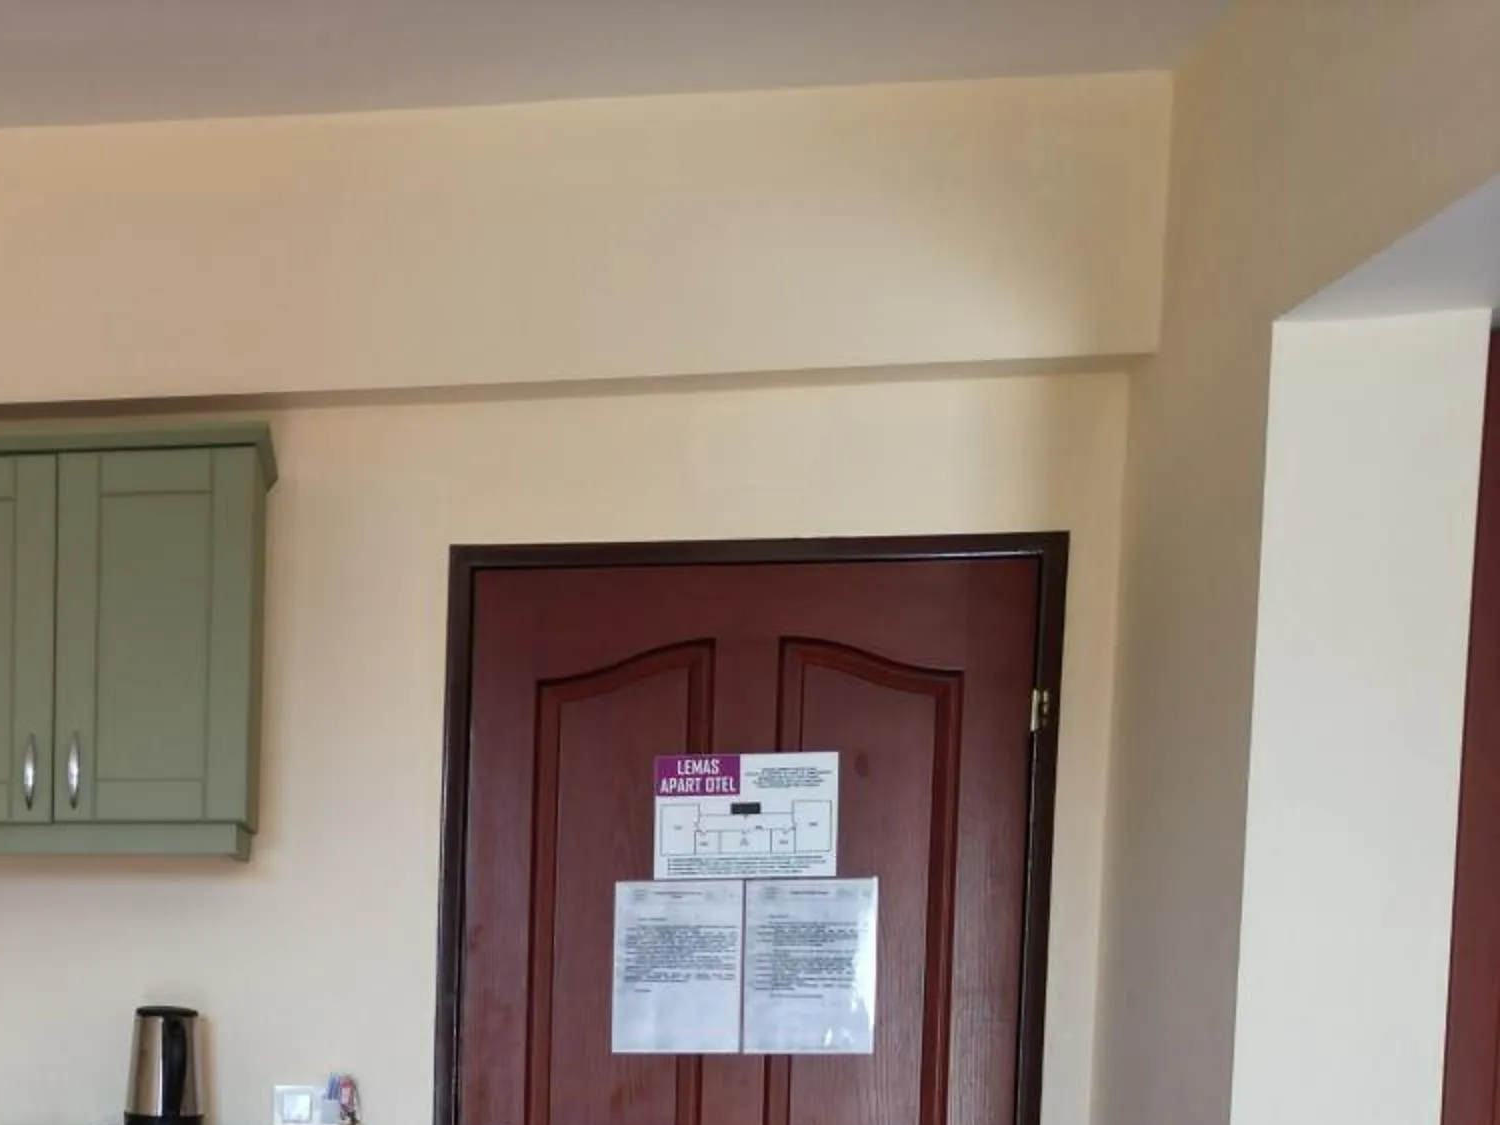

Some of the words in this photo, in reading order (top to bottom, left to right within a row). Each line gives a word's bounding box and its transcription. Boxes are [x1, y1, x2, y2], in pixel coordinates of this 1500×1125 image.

[677, 758, 720, 775] LEMAS
[659, 777, 702, 794] APART
[705, 776, 736, 793] OTEL
